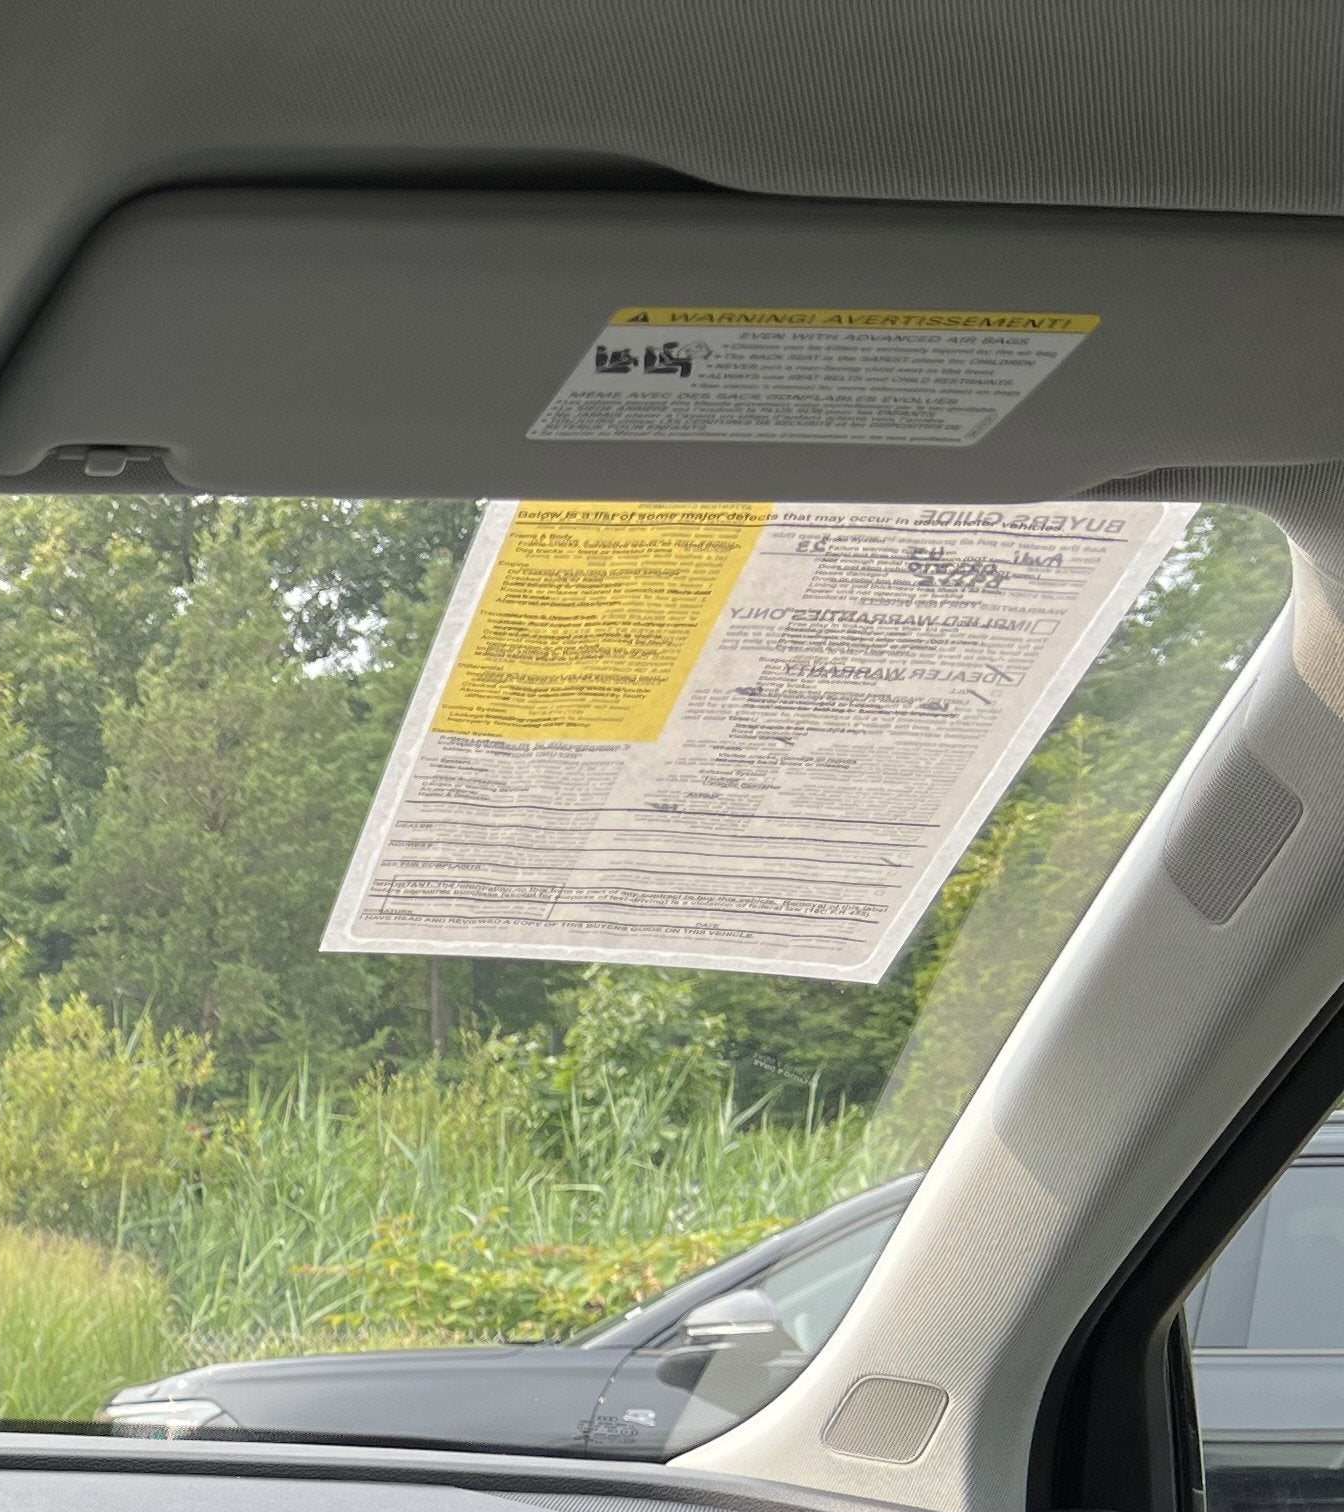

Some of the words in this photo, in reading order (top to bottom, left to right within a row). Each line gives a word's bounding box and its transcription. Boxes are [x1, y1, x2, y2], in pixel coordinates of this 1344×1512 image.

[670, 312, 817, 324] WARNING!
[822, 314, 1071, 329] AVERTISSEMENT!
[791, 333, 839, 341] WITH
[842, 333, 941, 343] ADVANCED
[945, 336, 977, 344] AIR
[981, 336, 1031, 345] BAGS
[517, 510, 562, 520] Below
[680, 511, 724, 523] major
[782, 512, 813, 522] that
[814, 515, 845, 526] may
[850, 515, 893, 524] occur
